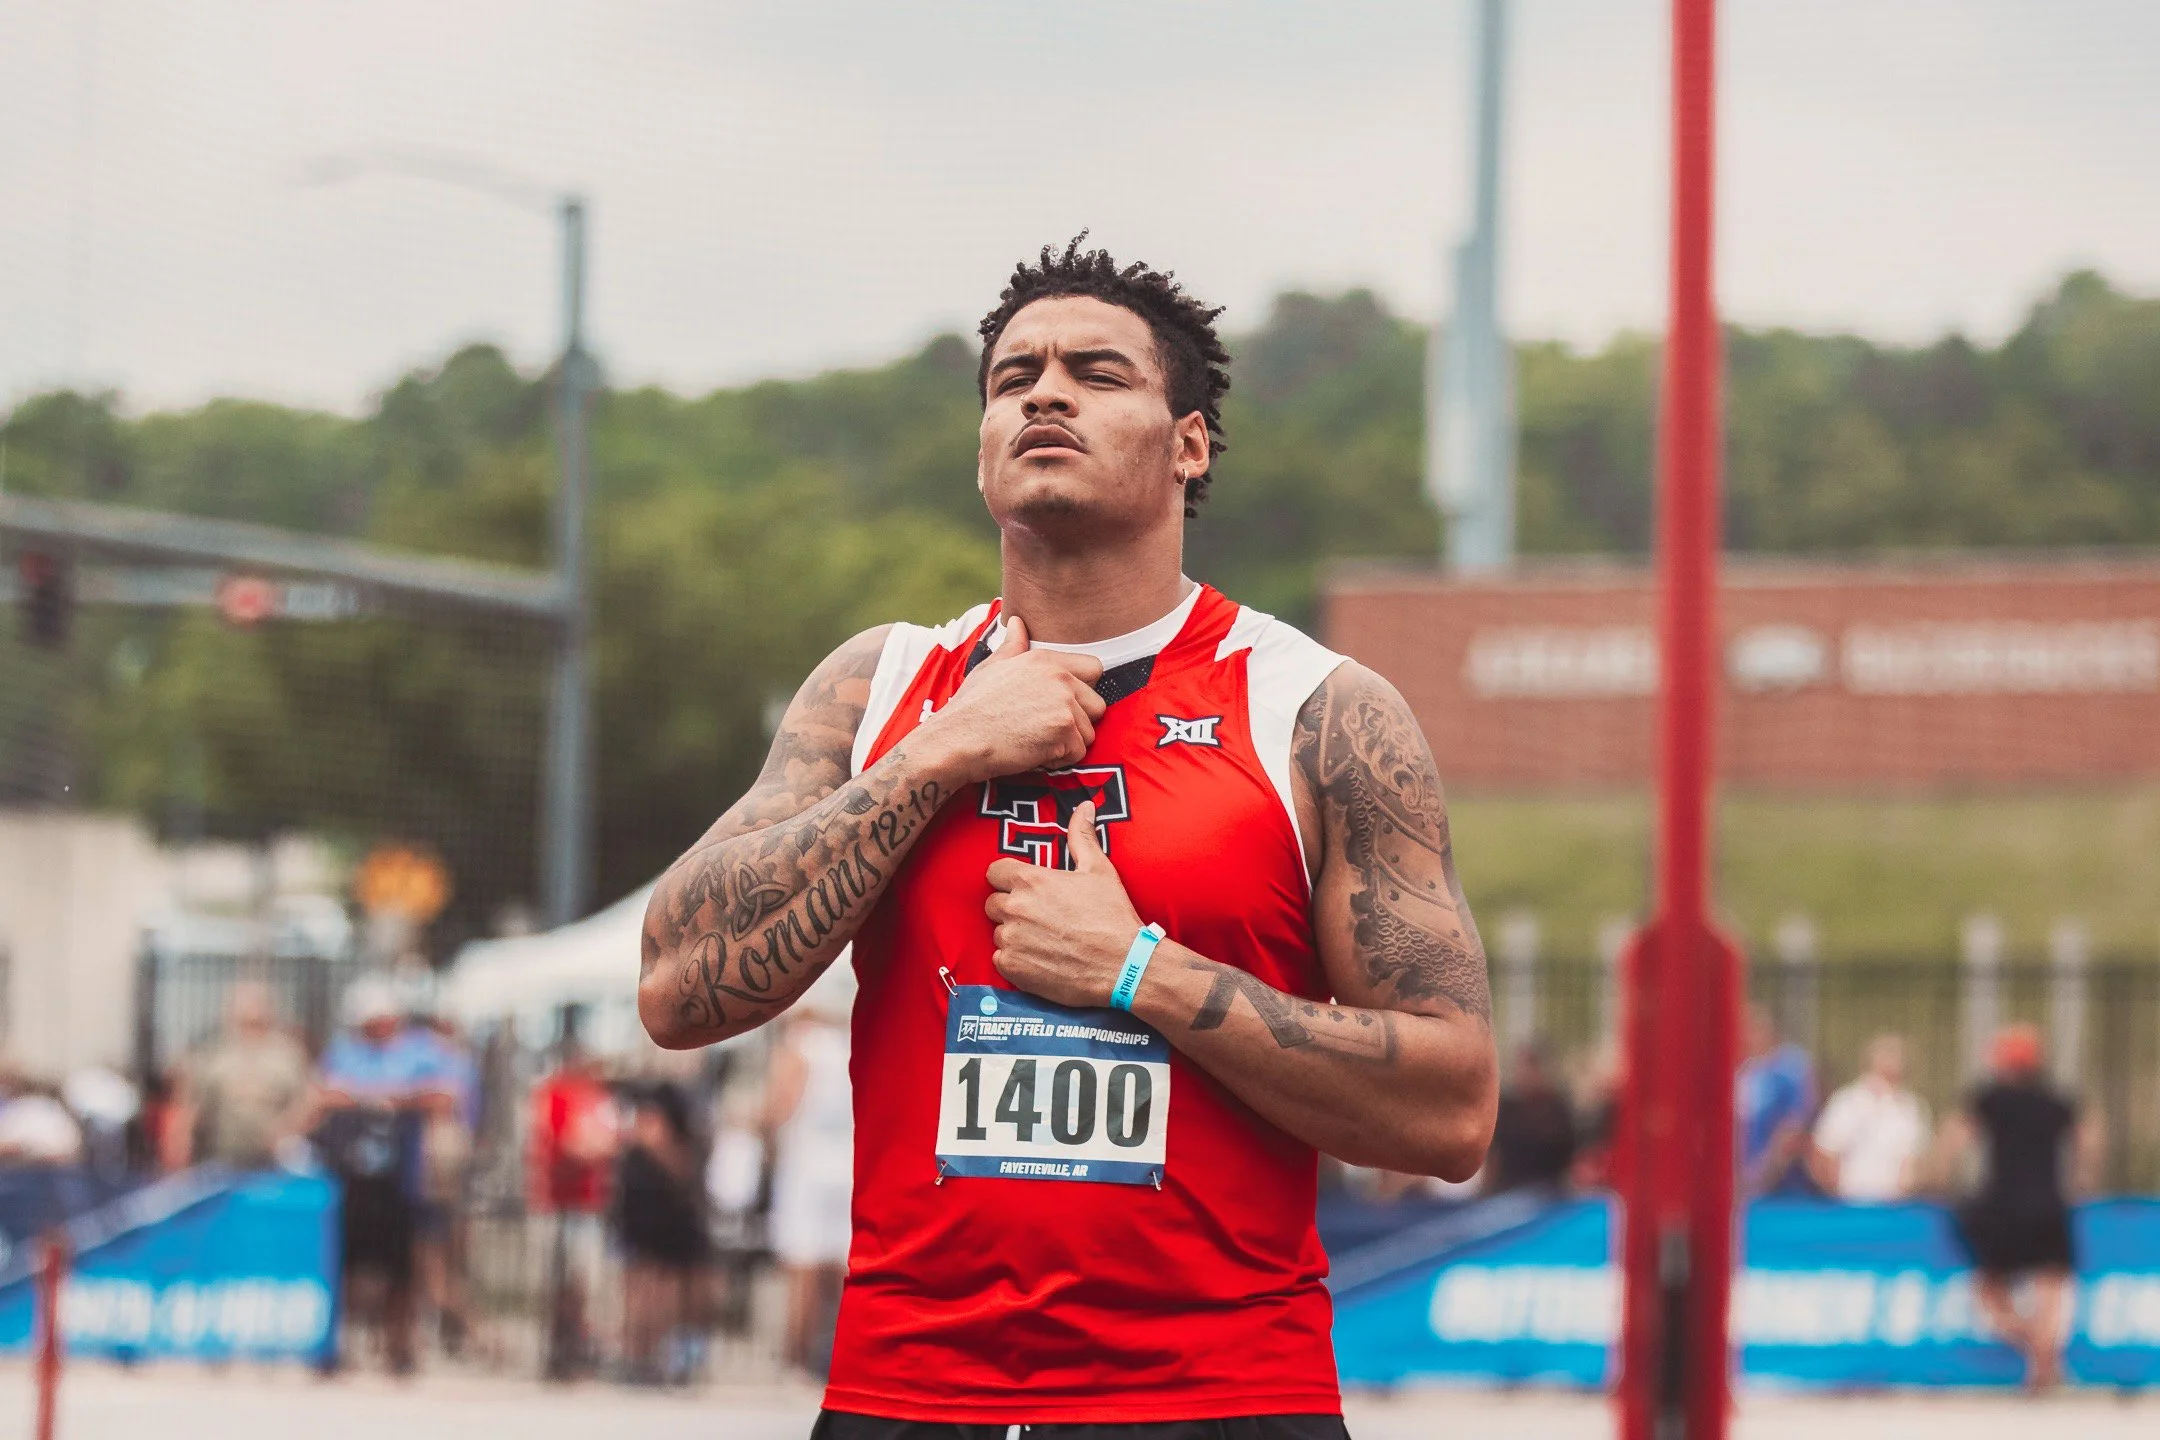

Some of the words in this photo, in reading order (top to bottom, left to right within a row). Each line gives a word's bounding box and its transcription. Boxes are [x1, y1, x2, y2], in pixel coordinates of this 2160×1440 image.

[1156, 714, 1223, 748] XII
[679, 843, 882, 1028] Romans
[868, 781, 950, 857] 12:12
[978, 1022, 1013, 1036] TRACK
[1022, 1024, 1055, 1037] FIELD
[1055, 1024, 1150, 1046] CHAMPIONSHIPS
[957, 1057, 1153, 1148] 1400
[1000, 1161, 1070, 1177] FAYETTEVILLE,
[1072, 1163, 1089, 1177] AR
